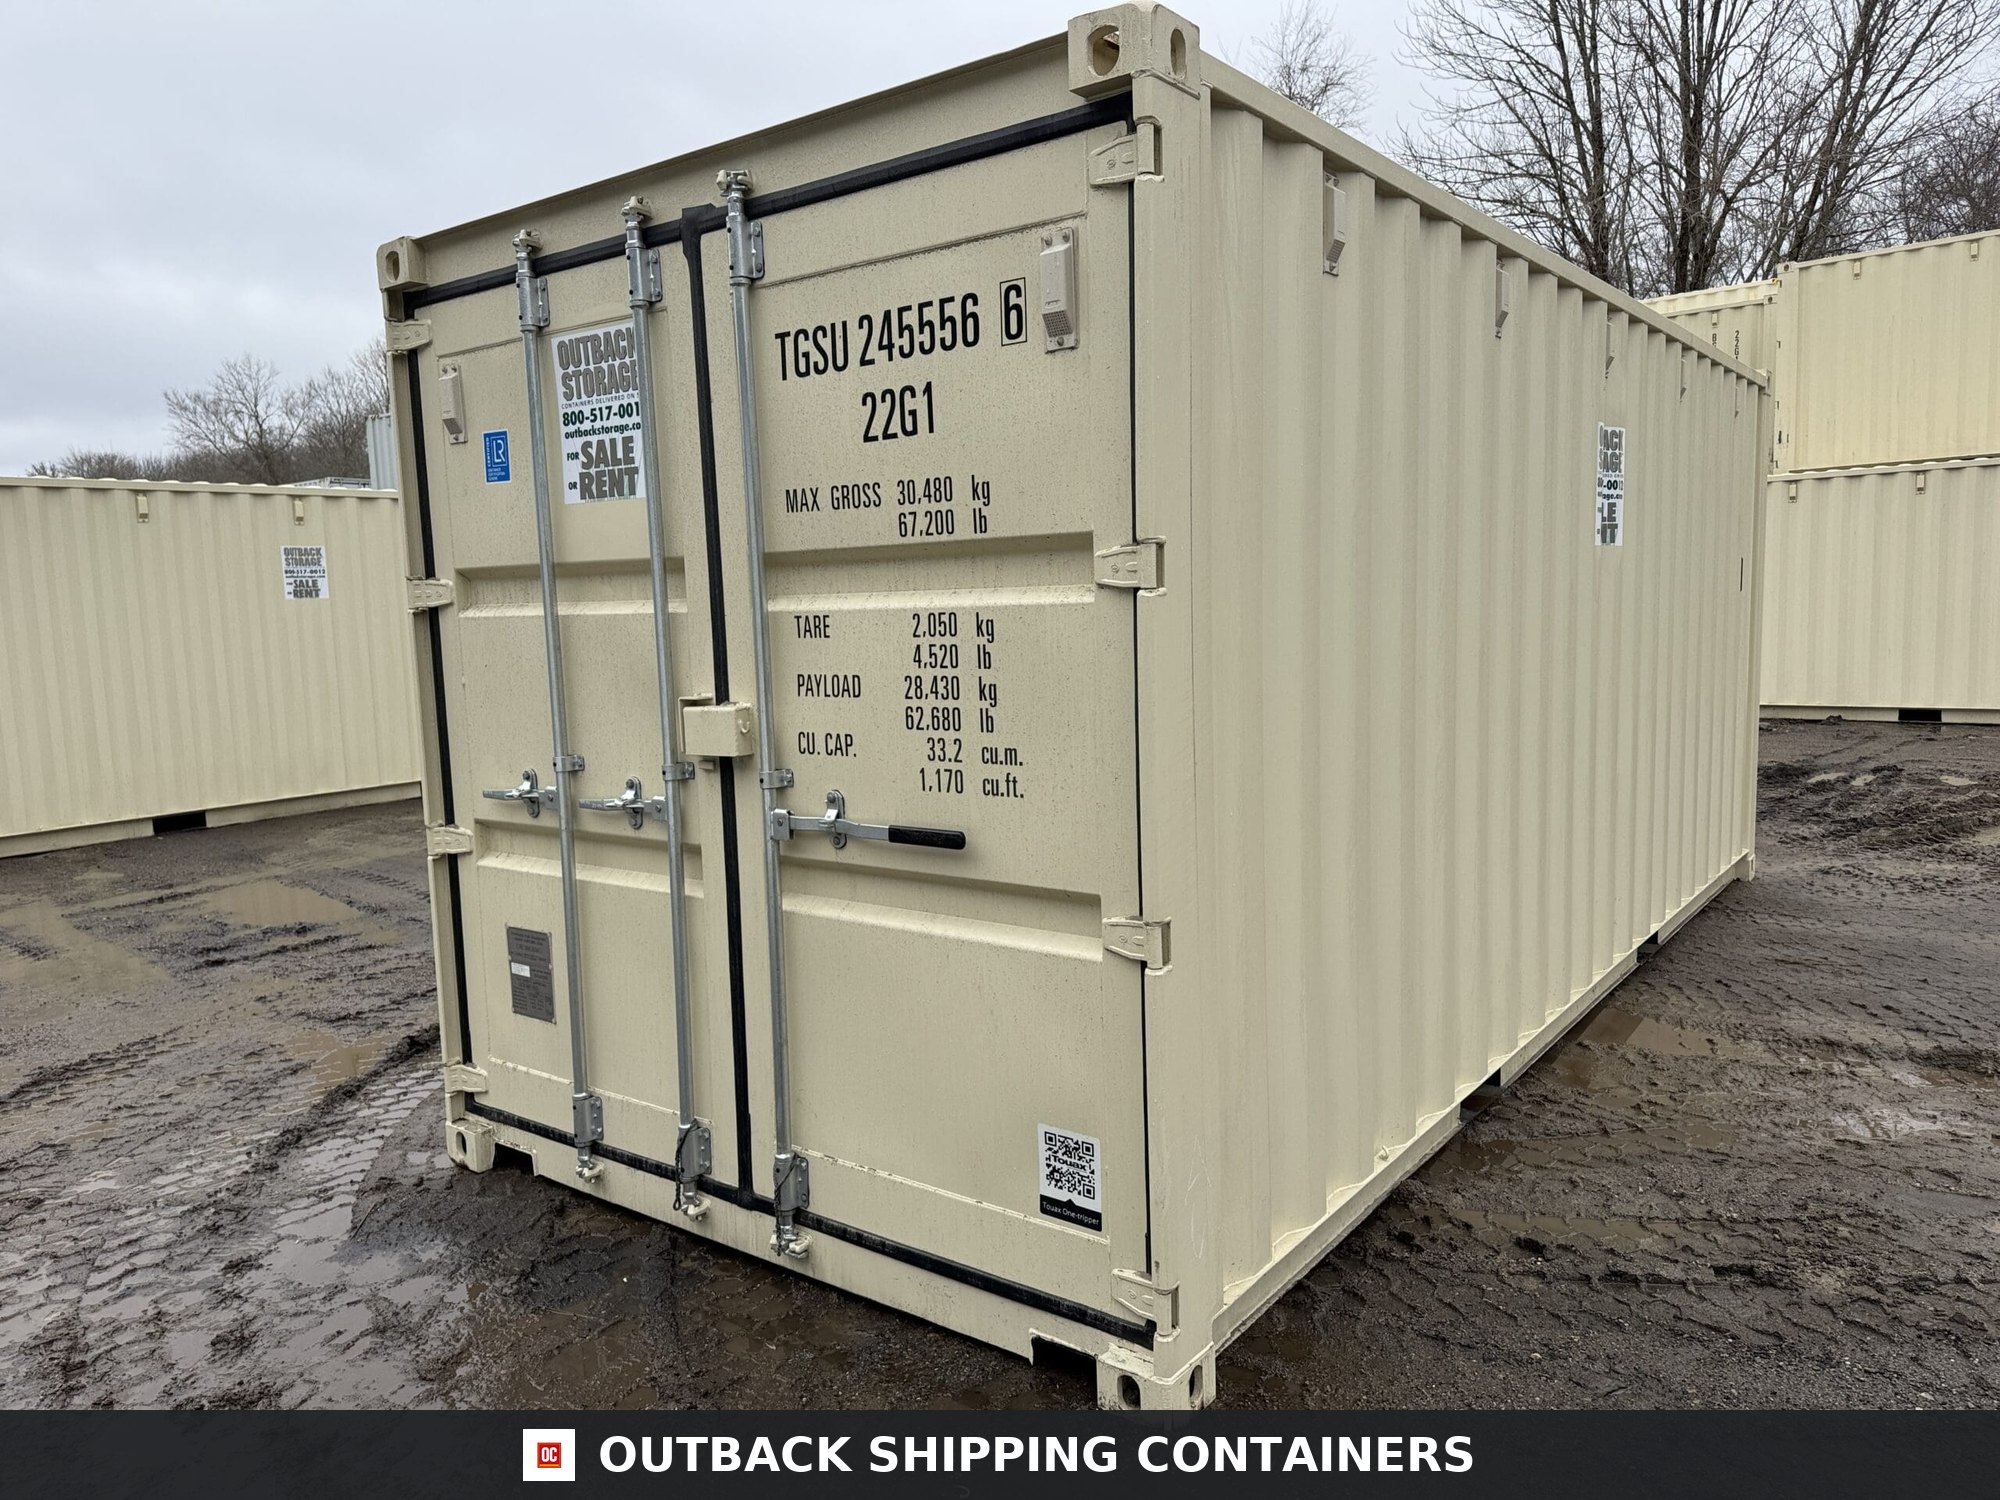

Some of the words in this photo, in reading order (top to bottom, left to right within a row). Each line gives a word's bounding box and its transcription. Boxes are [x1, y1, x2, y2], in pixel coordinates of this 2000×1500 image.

[775, 319, 849, 381] TGSU
[858, 292, 980, 367] 245556
[1003, 284, 1024, 340] 6
[557, 327, 636, 371] OUTBACK
[561, 359, 639, 402] STORAGE
[561, 399, 594, 410] CONTAINERS
[595, 394, 625, 405] DELIVERED
[626, 390, 635, 399] ON
[562, 401, 640, 427] 800-517-001
[861, 381, 934, 443] 22G1
[564, 422, 641, 440] outbackstorage.co
[493, 439, 505, 463] LR
[566, 451, 580, 462] FOR
[580, 435, 636, 471] SALE
[568, 481, 578, 490] OR
[579, 466, 639, 501] RENT
[785, 487, 820, 513] MAX
[830, 482, 882, 510] GROSS
[896, 476, 953, 506] 30,480
[971, 474, 991, 507] kg
[898, 509, 955, 538] 67,200
[972, 508, 988, 534] lb
[283, 547, 322, 557] OUTBACK
[284, 557, 322, 566] STORAGE
[293, 579, 318, 589] SALE
[293, 589, 320, 598] RENT
[794, 614, 831, 639] TARE
[912, 612, 958, 638] 2,050
[975, 611, 995, 643] kg
[913, 644, 959, 669] 4,520
[977, 644, 992, 670] lb
[797, 674, 862, 699] PAYLOAD
[904, 675, 960, 701] 28,430
[978, 676, 998, 708] kg
[905, 706, 962, 732] 62,680
[979, 707, 995, 734] lb
[798, 731, 821, 756] CU.
[825, 732, 857, 758] CAP.
[926, 737, 963, 763] 33.2
[981, 745, 1024, 767] cu.m.
[919, 767, 964, 794] 1,170
[982, 772, 1025, 799] cu.ft.
[1052, 1155, 1087, 1172] Touax
[1042, 1201, 1062, 1214] Touax
[1062, 1207, 1100, 1226] One-tripper
